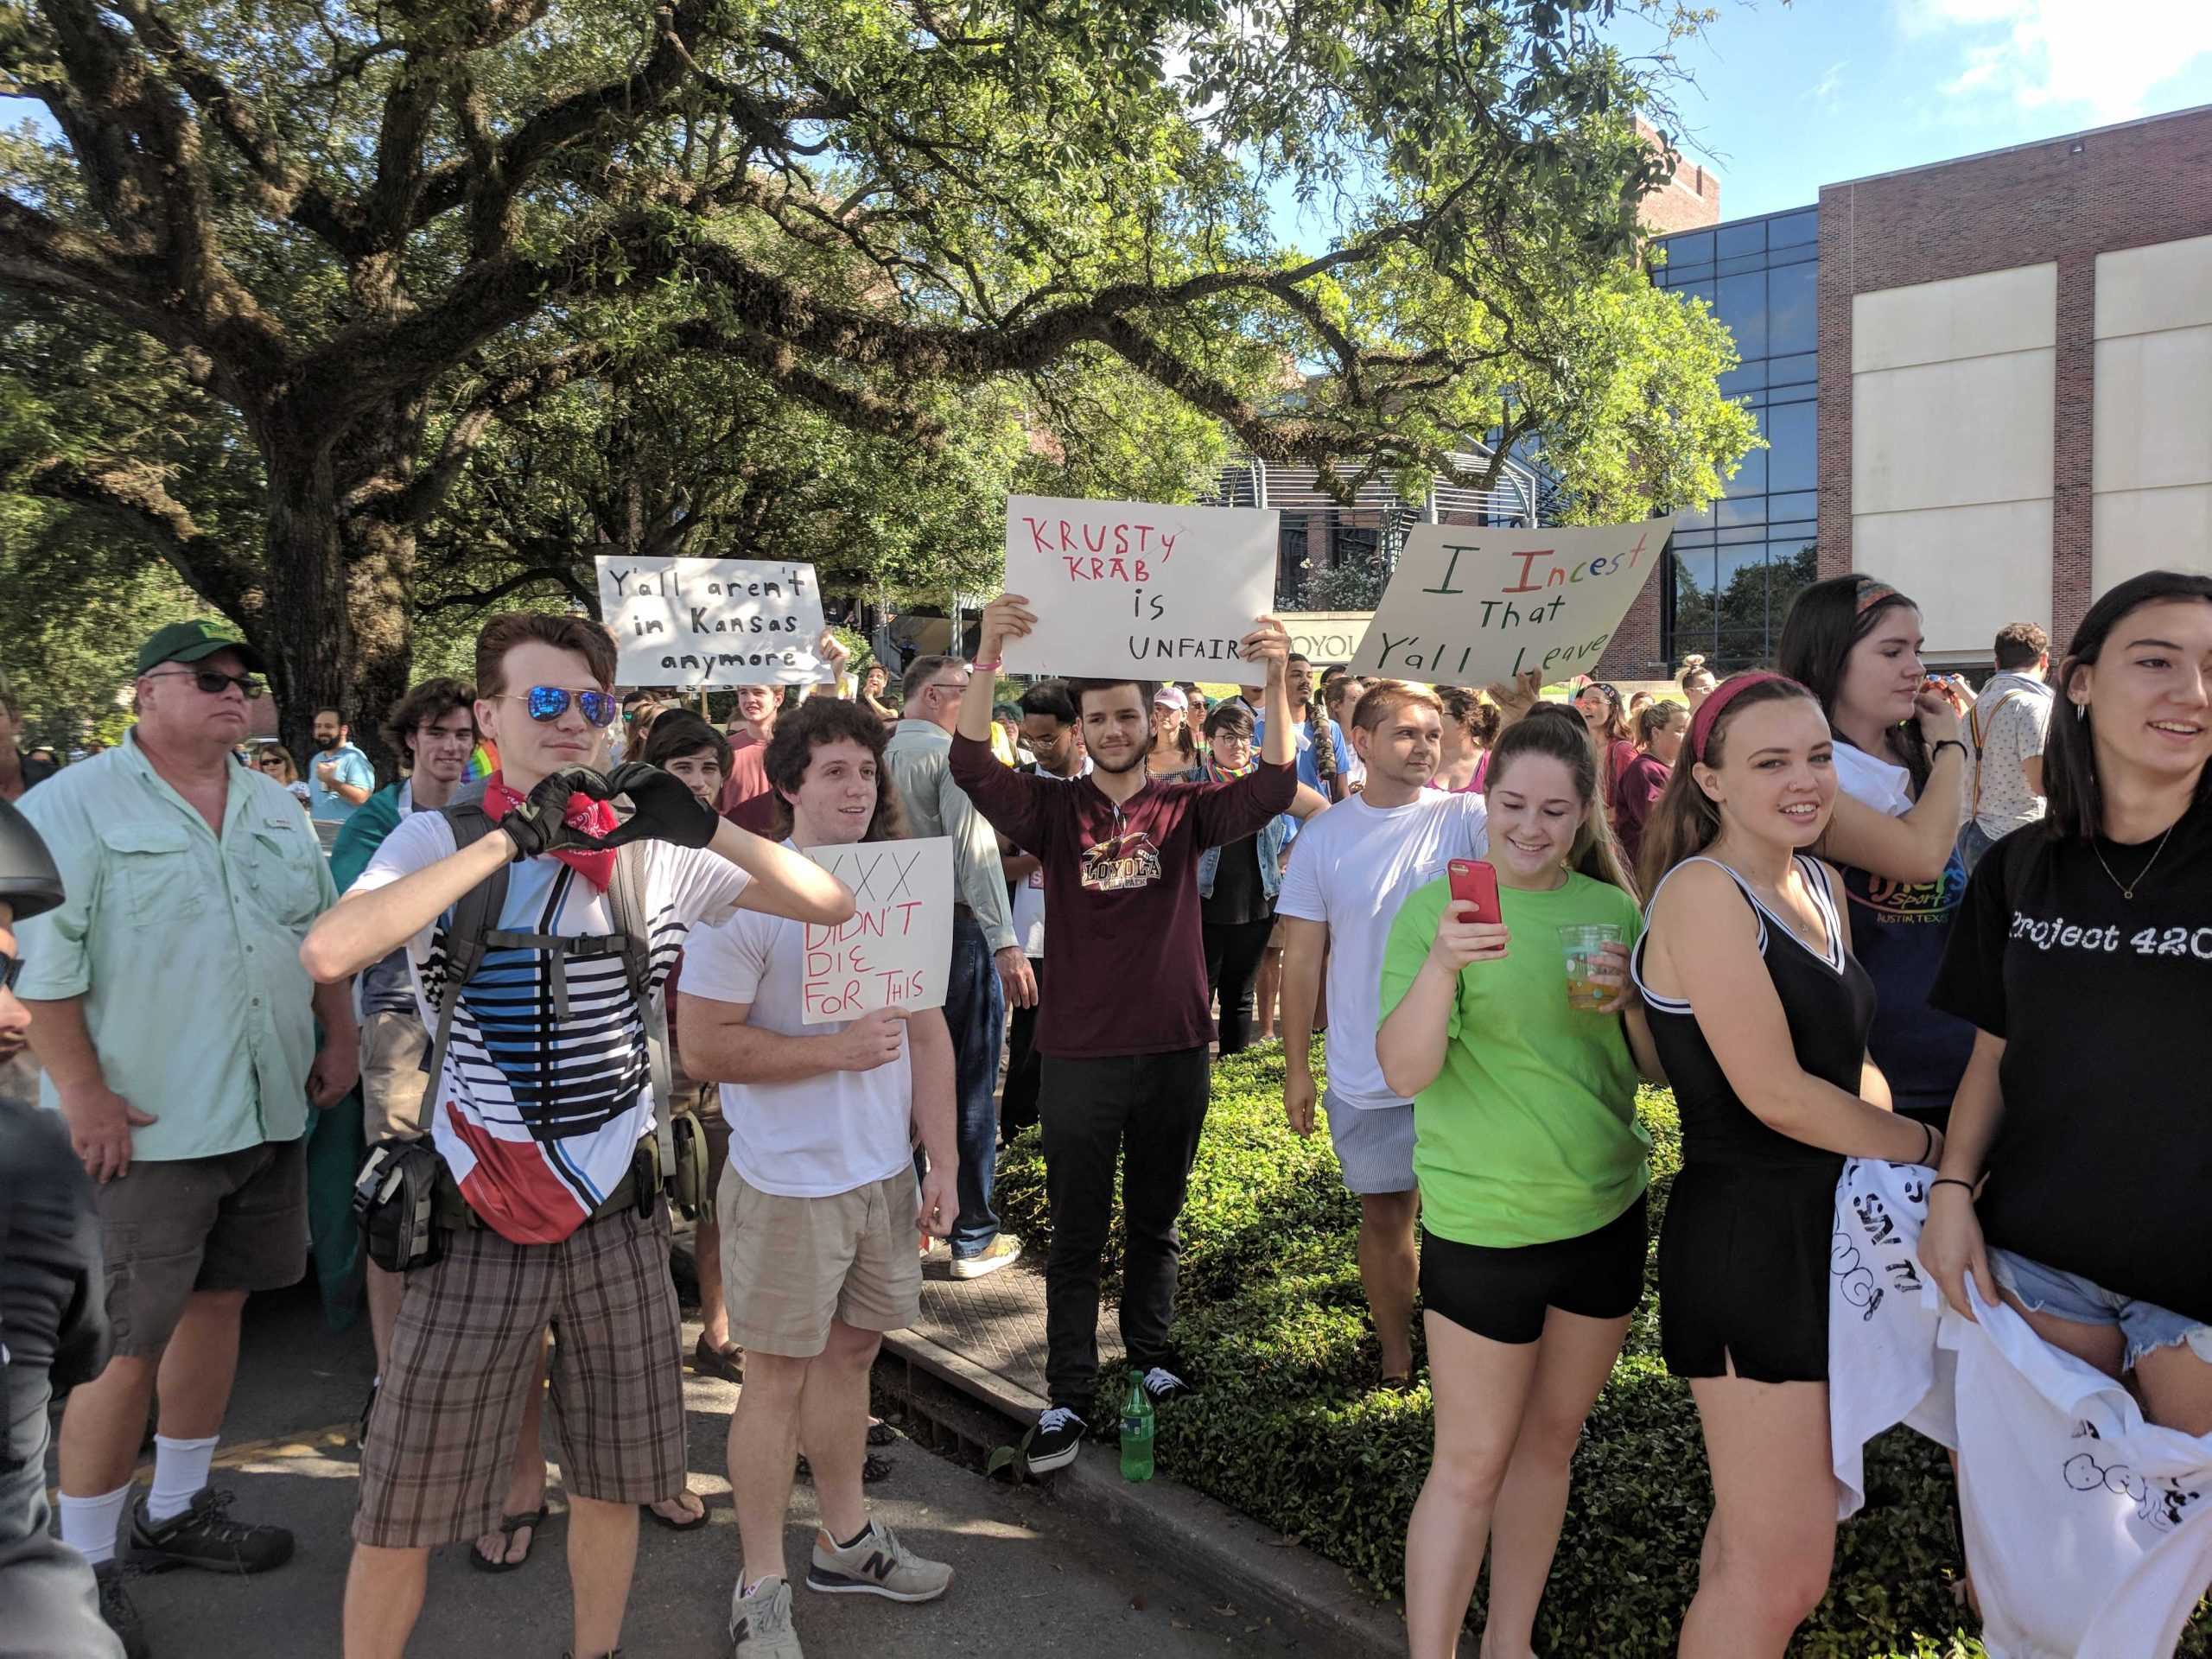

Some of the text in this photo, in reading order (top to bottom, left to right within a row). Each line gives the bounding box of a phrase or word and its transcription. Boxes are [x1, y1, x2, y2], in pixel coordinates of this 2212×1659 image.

[1063, 556, 1150, 582] KRAB
[1422, 532, 1647, 594] I Incest
[609, 566, 805, 598] Y'all aren't
[1134, 588, 1165, 620] is
[1480, 594, 1566, 630] That
[633, 607, 798, 636] in Kansas
[1128, 635, 1241, 661] UNFAIR
[1291, 635, 1356, 657] OYOL
[1377, 632, 1609, 677] Y'all Leave
[661, 652, 797, 680] anymore
[1084, 858, 1161, 885] LOYOLA
[808, 944, 876, 977] DIE
[874, 969, 924, 1006] THIS
